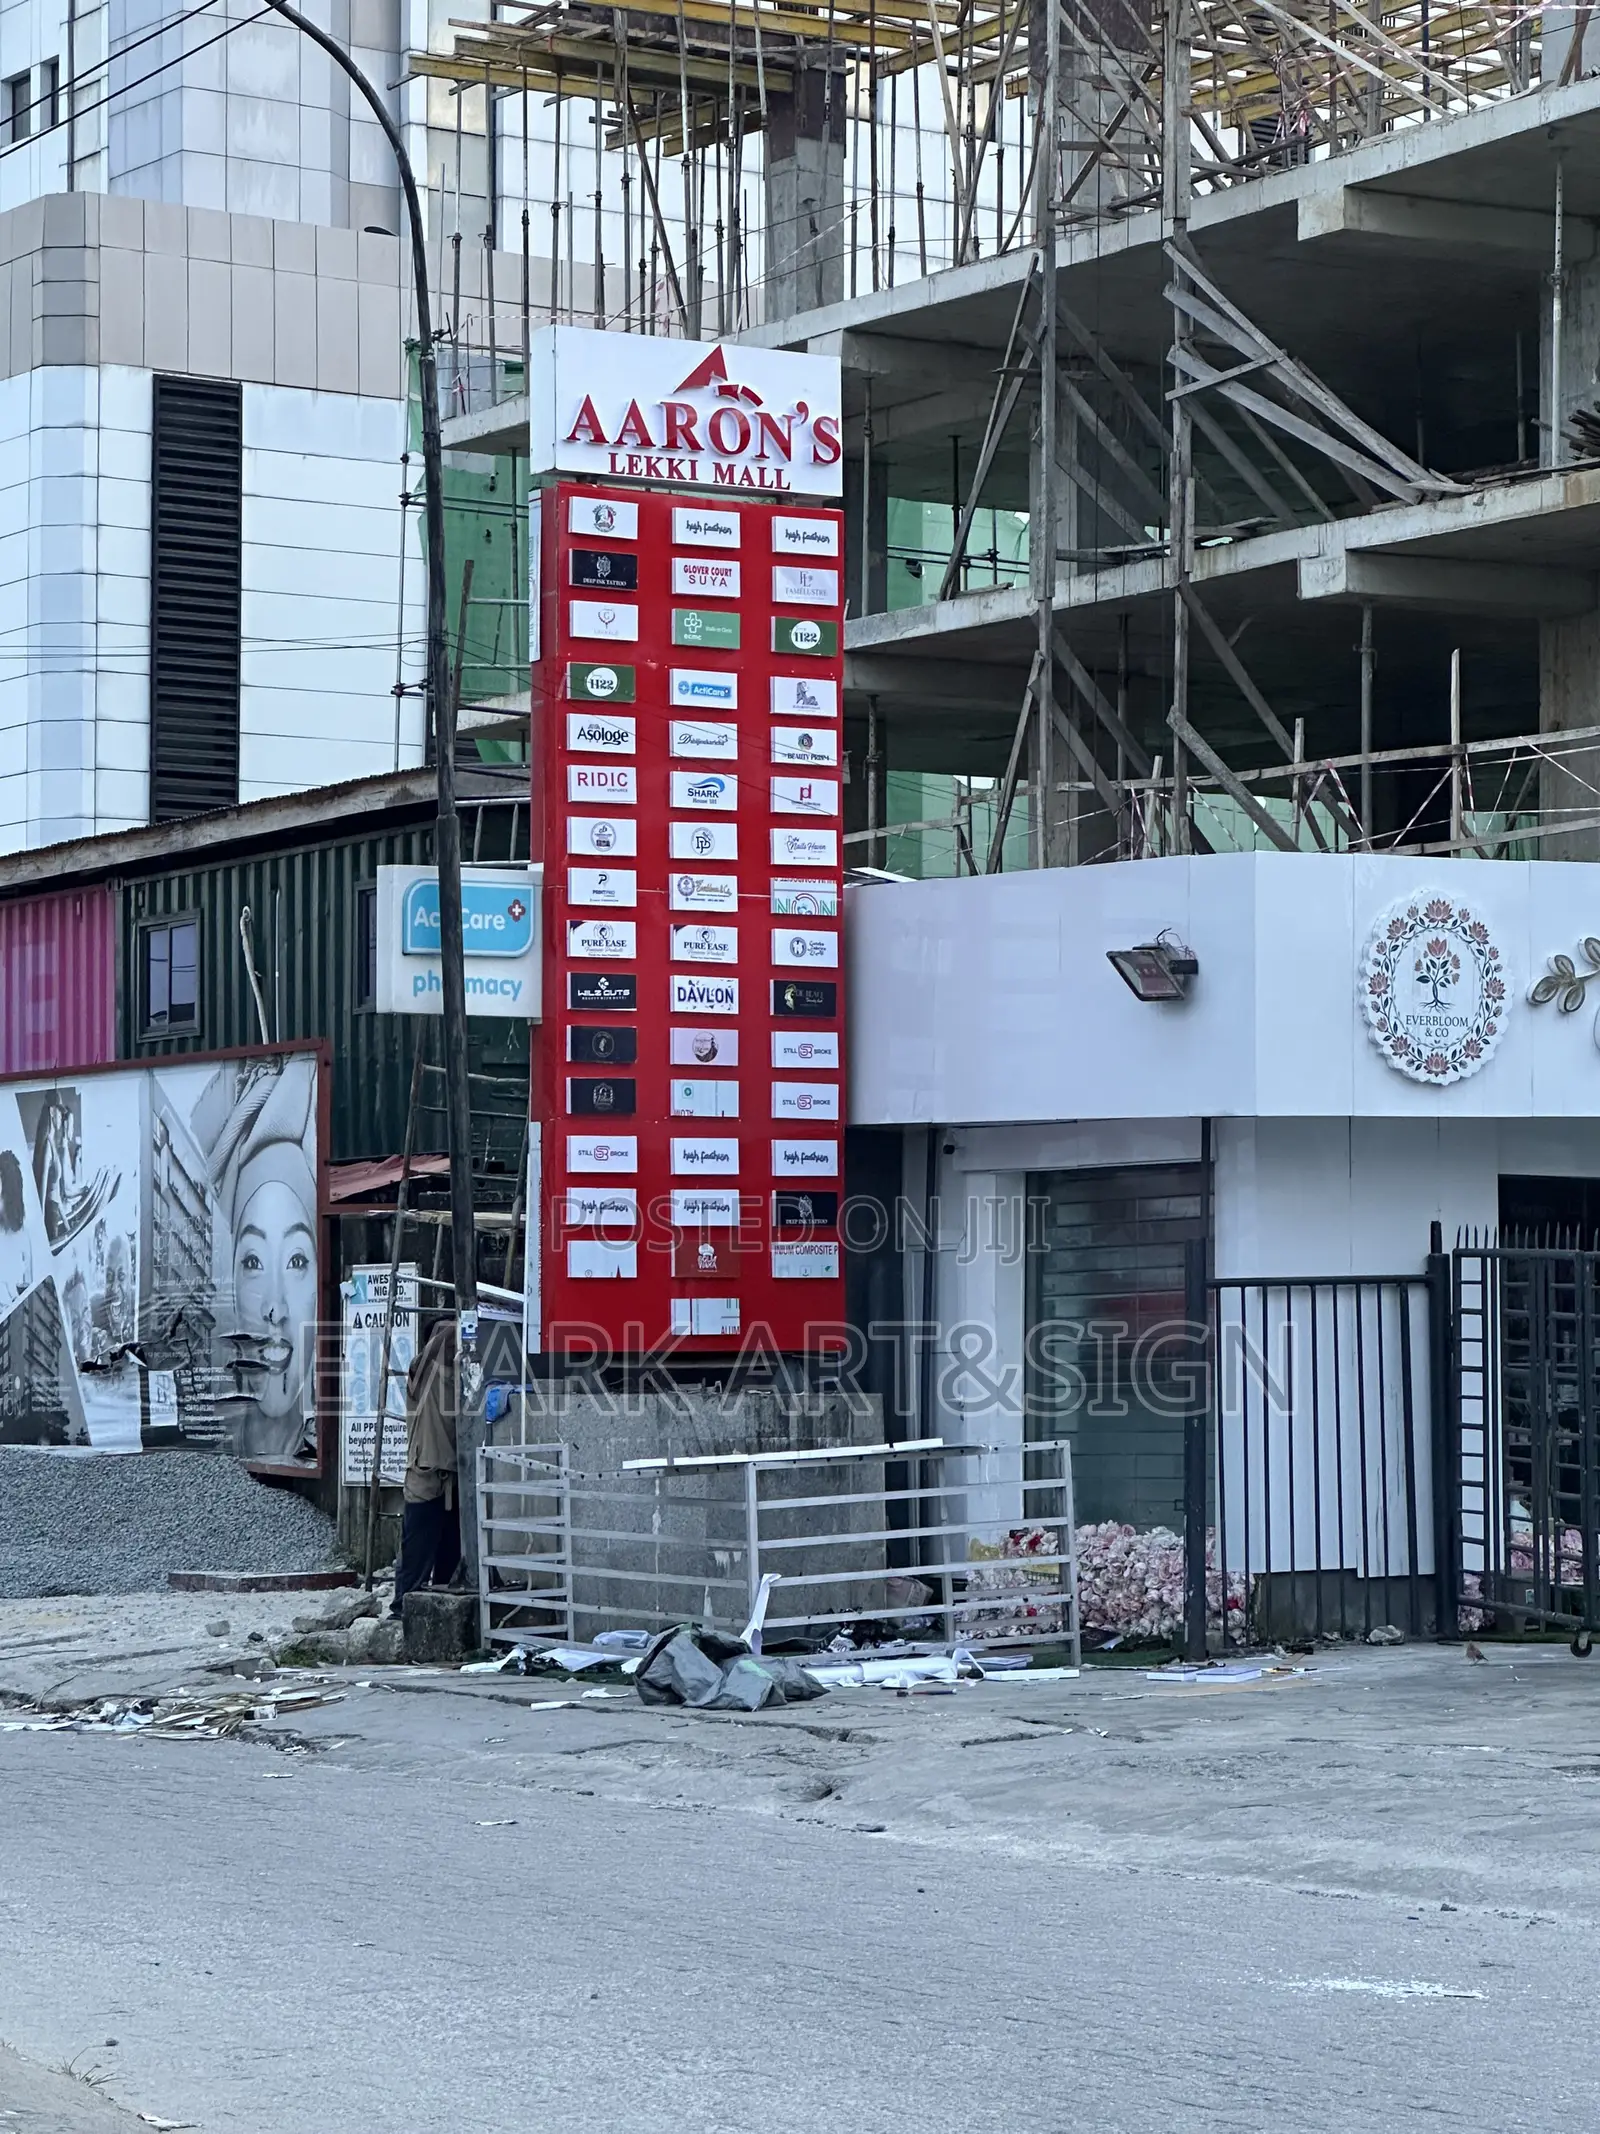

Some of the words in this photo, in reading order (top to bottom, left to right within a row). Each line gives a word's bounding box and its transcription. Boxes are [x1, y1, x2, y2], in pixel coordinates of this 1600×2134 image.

[565, 393, 842, 466] AARON'S
[608, 452, 699, 481] LEKKI
[712, 462, 791, 491] MALL
[683, 564, 709, 576] GLOVER
[711, 566, 732, 577] COURT
[688, 574, 728, 587] SUYA
[693, 686, 726, 698] ActiCare
[577, 772, 628, 787] RIDIC
[687, 787, 719, 799] SHARK
[581, 939, 604, 948] PURE
[604, 939, 627, 948] EASE
[683, 941, 707, 950] PURE
[707, 942, 729, 952] EASE
[412, 969, 523, 1001] phmacy
[1405, 1014, 1469, 1028] EVERBLOOM
[1424, 1028, 1433, 1038] &
[1434, 1027, 1449, 1038] CO
[682, 1149, 700, 1164] high
[783, 1150, 799, 1164] high
[795, 1245, 833, 1255] COMPOSITE
[351, 1422, 362, 1432] All
